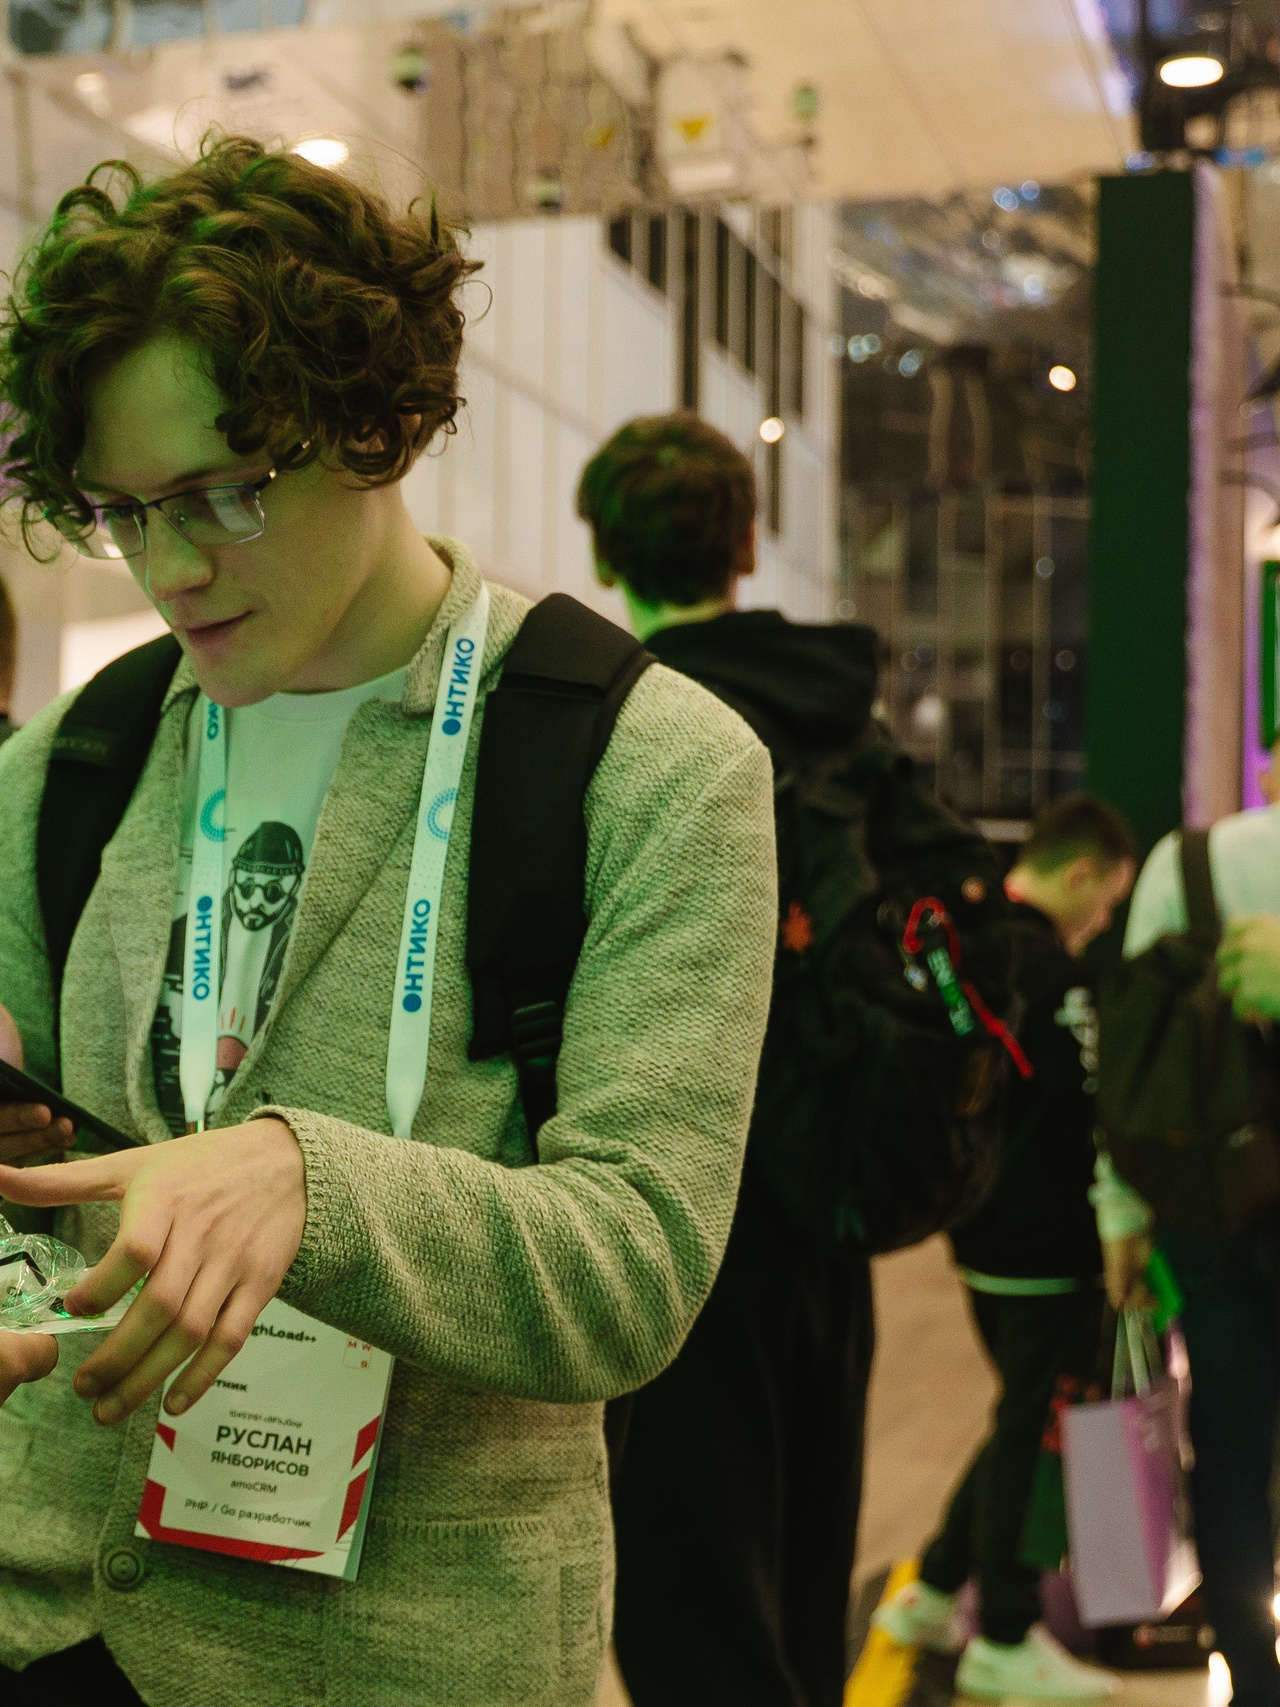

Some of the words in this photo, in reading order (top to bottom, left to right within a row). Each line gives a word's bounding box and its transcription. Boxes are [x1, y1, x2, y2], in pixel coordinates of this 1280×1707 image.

[250, 1323, 317, 1342] ghLoad++
[216, 1379, 248, 1392] тник
[216, 1425, 312, 1456] РУСЛАН
[210, 1450, 309, 1476] ЯНБОРИСОВ
[230, 1480, 277, 1493] amoCRM
[238, 1510, 311, 1528] разработчик
